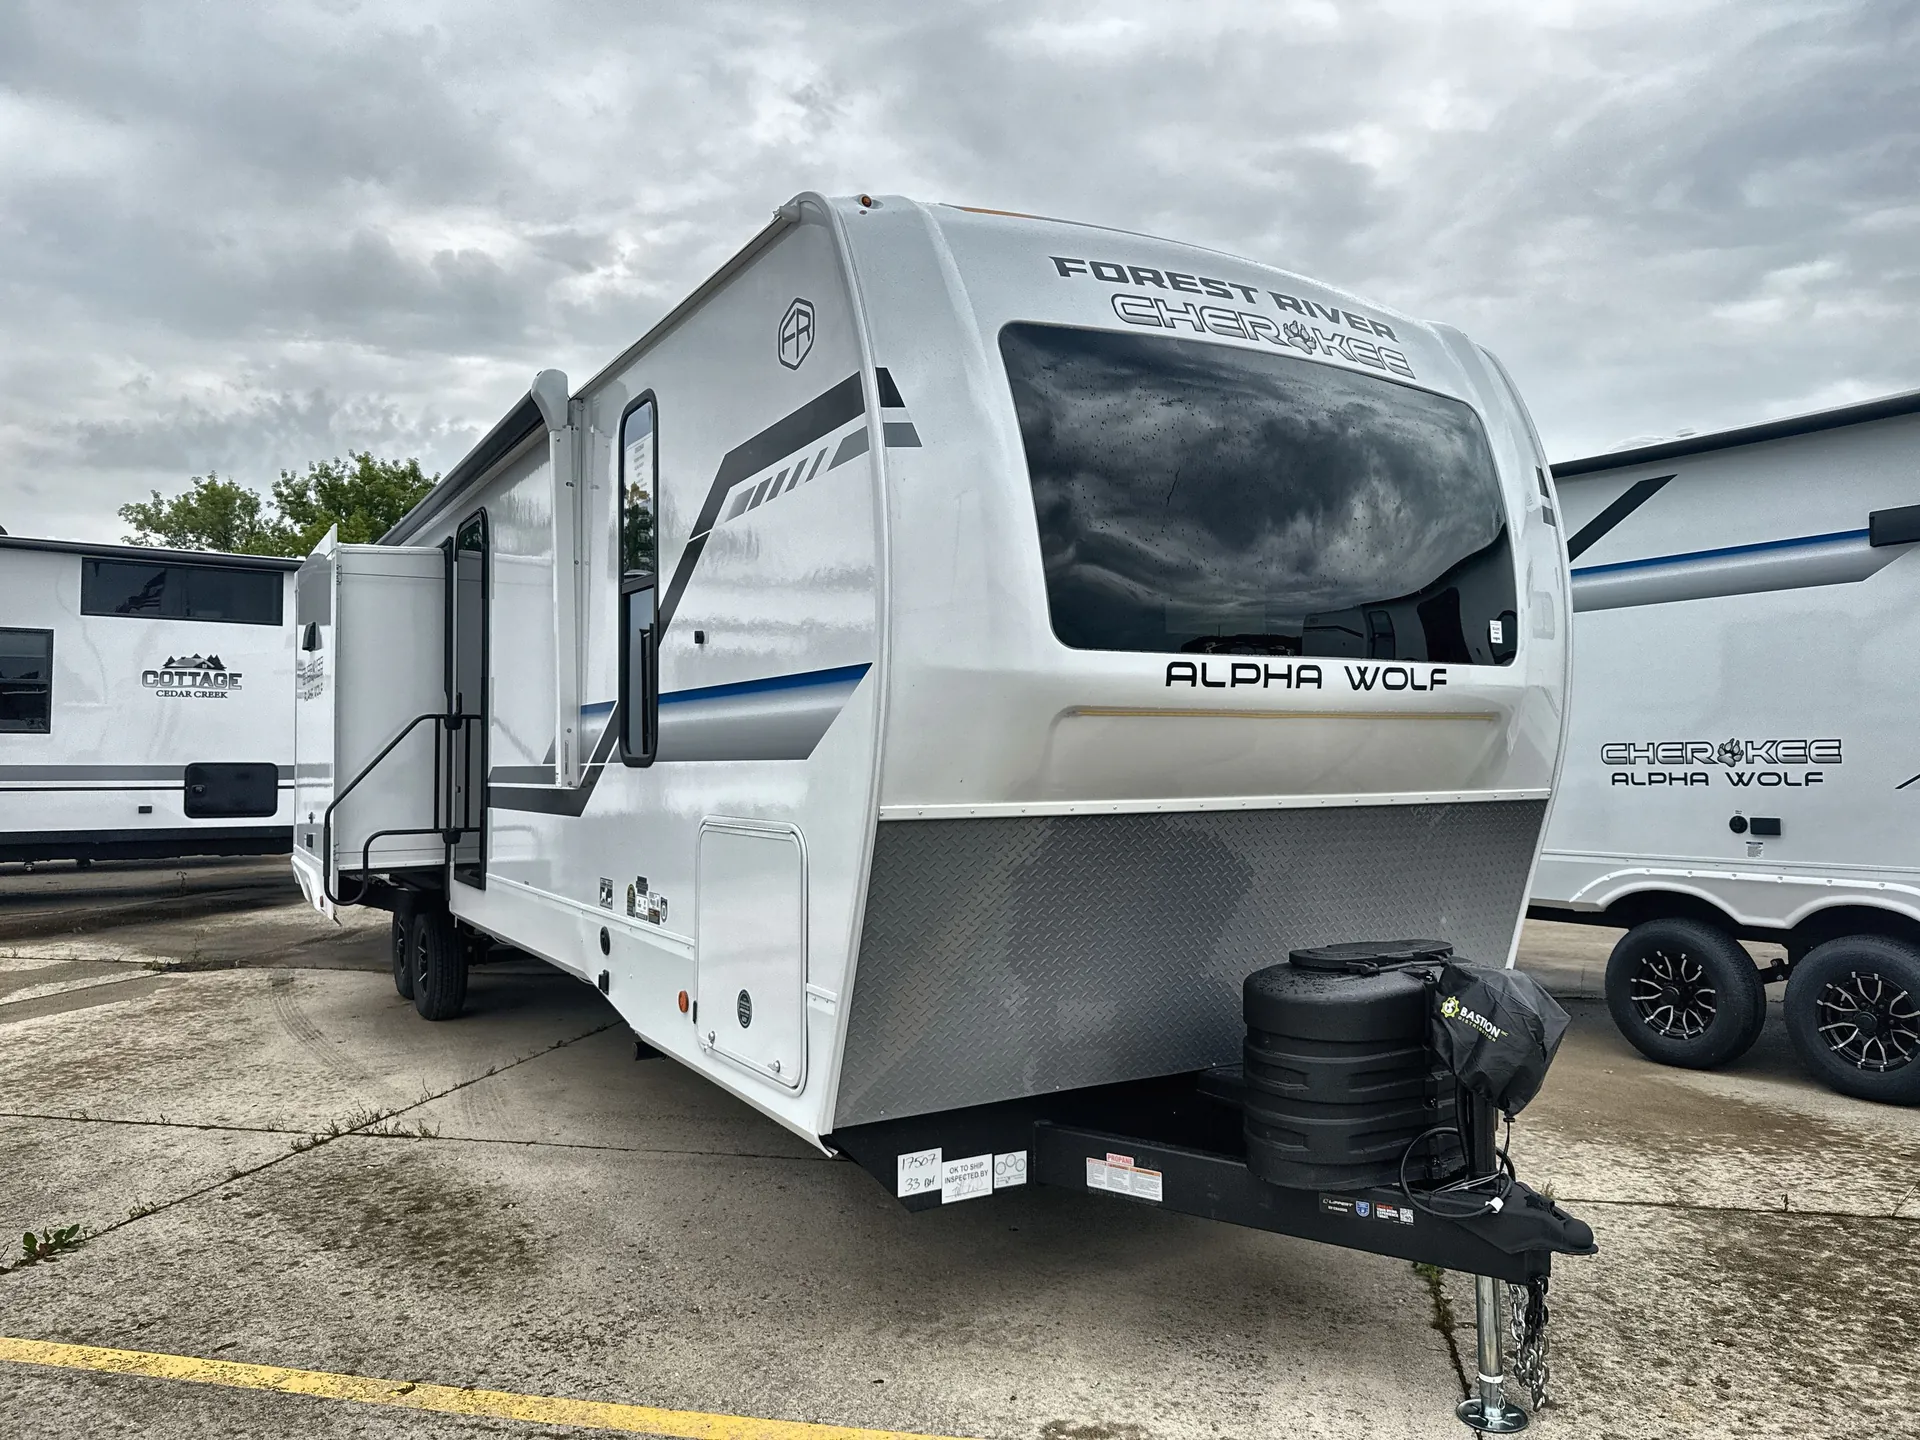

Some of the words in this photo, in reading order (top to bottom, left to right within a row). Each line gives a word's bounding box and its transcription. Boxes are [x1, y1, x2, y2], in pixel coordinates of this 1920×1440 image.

[1050, 255, 1259, 305] FOREST
[1267, 289, 1400, 343] RIVER
[141, 670, 243, 691] COTTAGE
[1165, 661, 1323, 690] ALPHA
[1344, 665, 1447, 692] WOLF
[156, 689, 193, 698] CEDAR
[193, 690, 229, 699] CREEK
[1611, 772, 1710, 787] ALPHA
[1725, 771, 1824, 787] WOLF
[1459, 1006, 1501, 1038] BASTION
[902, 1153, 937, 1172] 17507
[949, 1165, 959, 1174] OK
[960, 1163, 969, 1173] TO
[969, 1161, 984, 1171] SHIP
[1107, 1154, 1133, 1165] PROPANE
[944, 1171, 980, 1184] INSPECTED
[980, 1168, 989, 1178] BY
[904, 1177, 921, 1193] 33
